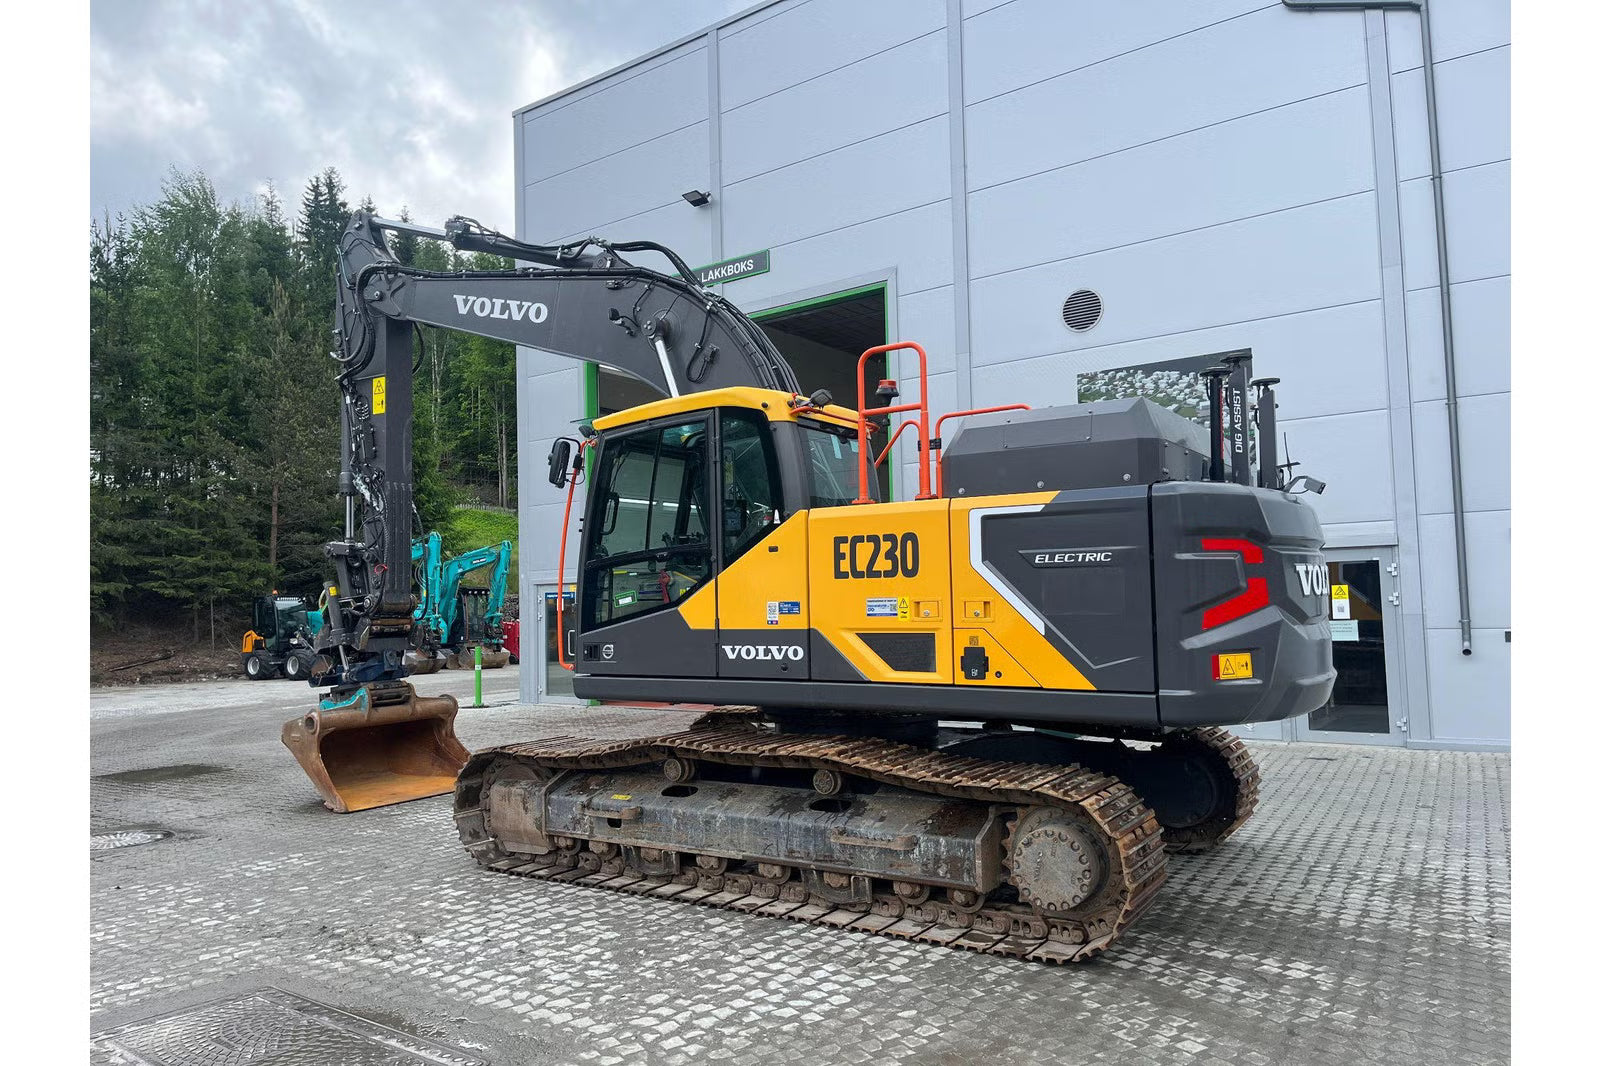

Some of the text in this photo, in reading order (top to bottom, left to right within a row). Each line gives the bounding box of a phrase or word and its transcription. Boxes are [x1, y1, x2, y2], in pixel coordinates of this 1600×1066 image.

[701, 259, 755, 283] LAKKBOKS
[453, 295, 548, 324] VOLVO
[1232, 387, 1244, 454] DIG ASSIST
[833, 532, 920, 580] EC230
[1034, 550, 1113, 565] ELECTRIC
[721, 644, 805, 662] VOLVO
